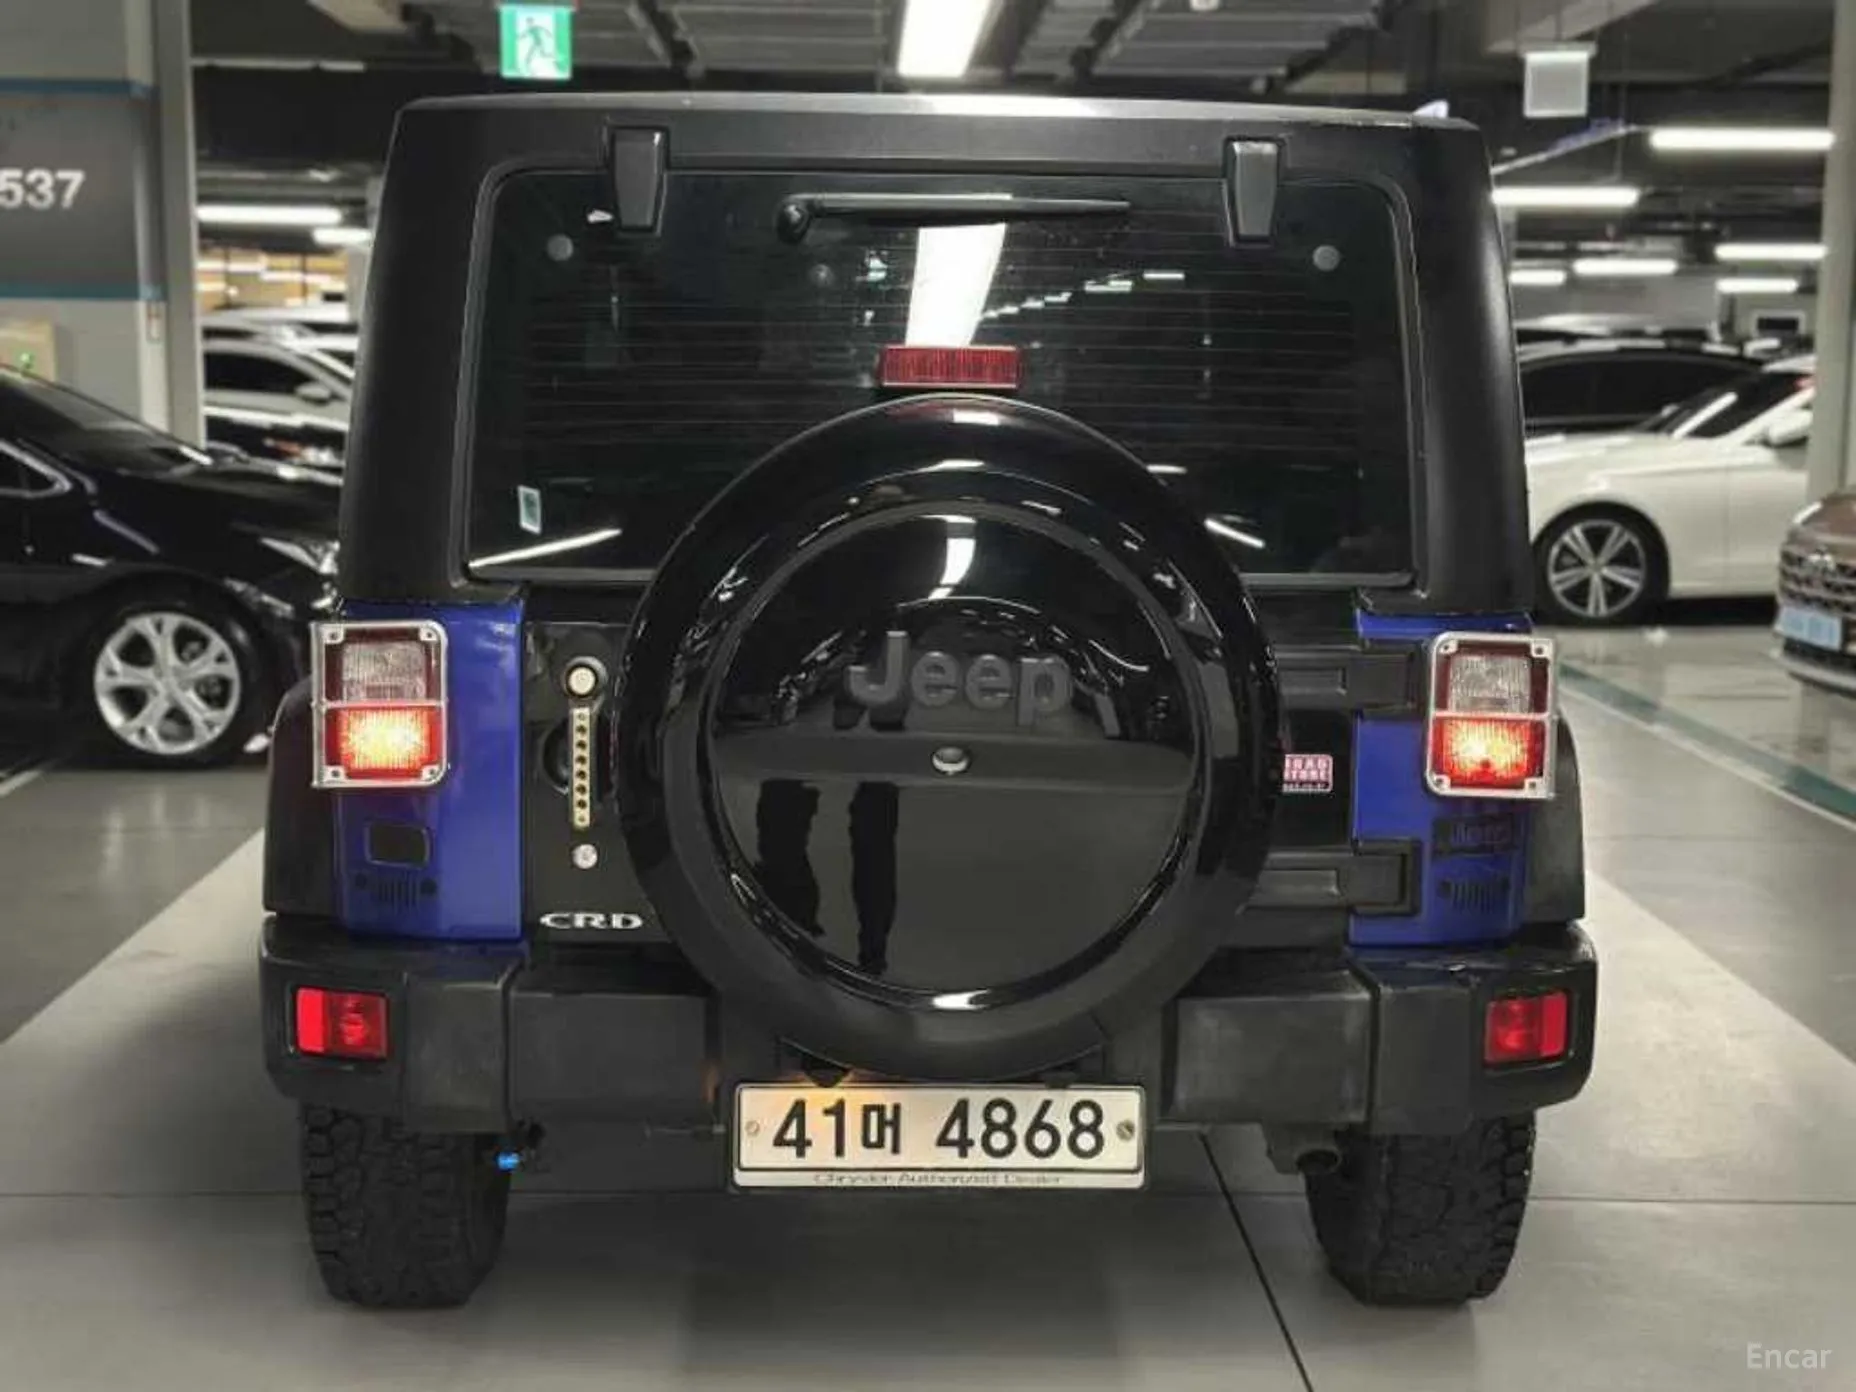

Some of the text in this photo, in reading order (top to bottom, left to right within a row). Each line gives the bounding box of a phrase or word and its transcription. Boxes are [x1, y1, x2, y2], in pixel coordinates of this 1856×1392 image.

[0, 168, 86, 210] 537
[848, 630, 1072, 726] Jeep
[540, 912, 643, 930] CRD
[773, 1097, 1105, 1160] 41머 4868
